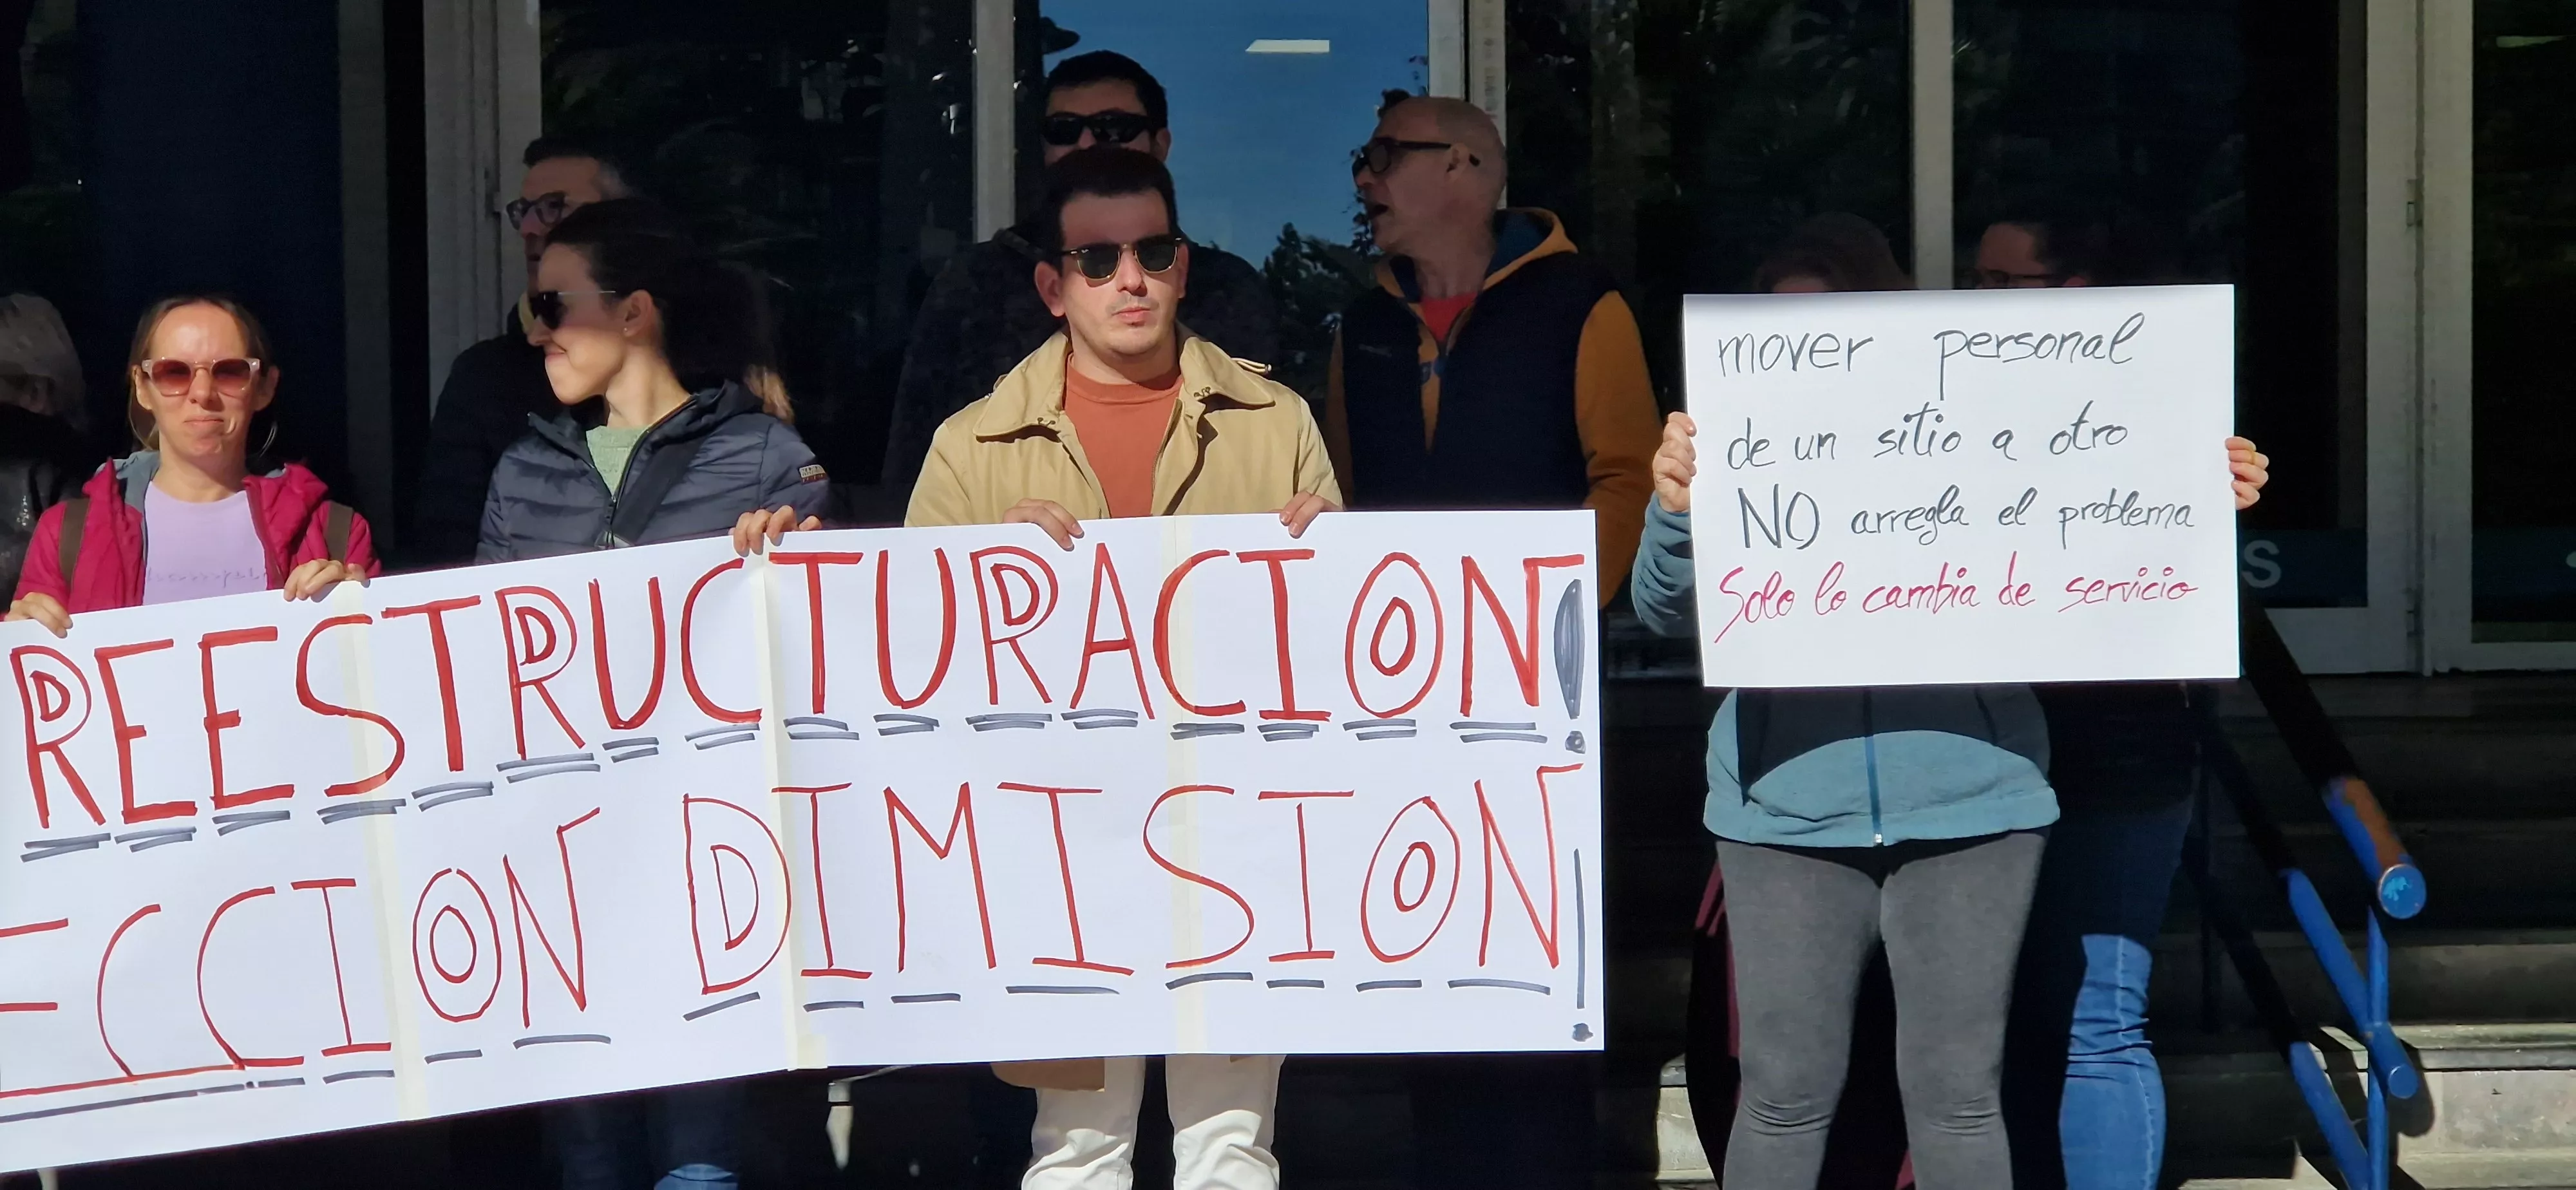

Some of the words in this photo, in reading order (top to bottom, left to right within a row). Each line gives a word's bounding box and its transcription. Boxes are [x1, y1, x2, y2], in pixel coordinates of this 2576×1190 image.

[1718, 332, 1875, 377] mover
[1933, 312, 2145, 402] personal
[1727, 417, 1776, 471] de
[1794, 432, 1837, 461] un
[1873, 401, 1962, 458] sitio
[1991, 430, 2018, 461] a
[2049, 400, 2128, 457] otro
[1737, 483, 1821, 550] NO
[1850, 484, 1970, 546] arregla
[1998, 487, 2039, 527] el
[2058, 487, 2195, 551] problema
[1714, 565, 1796, 645] Solo
[1814, 561, 1848, 617] lo
[1861, 563, 1982, 615] cambia
[1998, 551, 2036, 607] de
[2058, 567, 2199, 614] servicio
